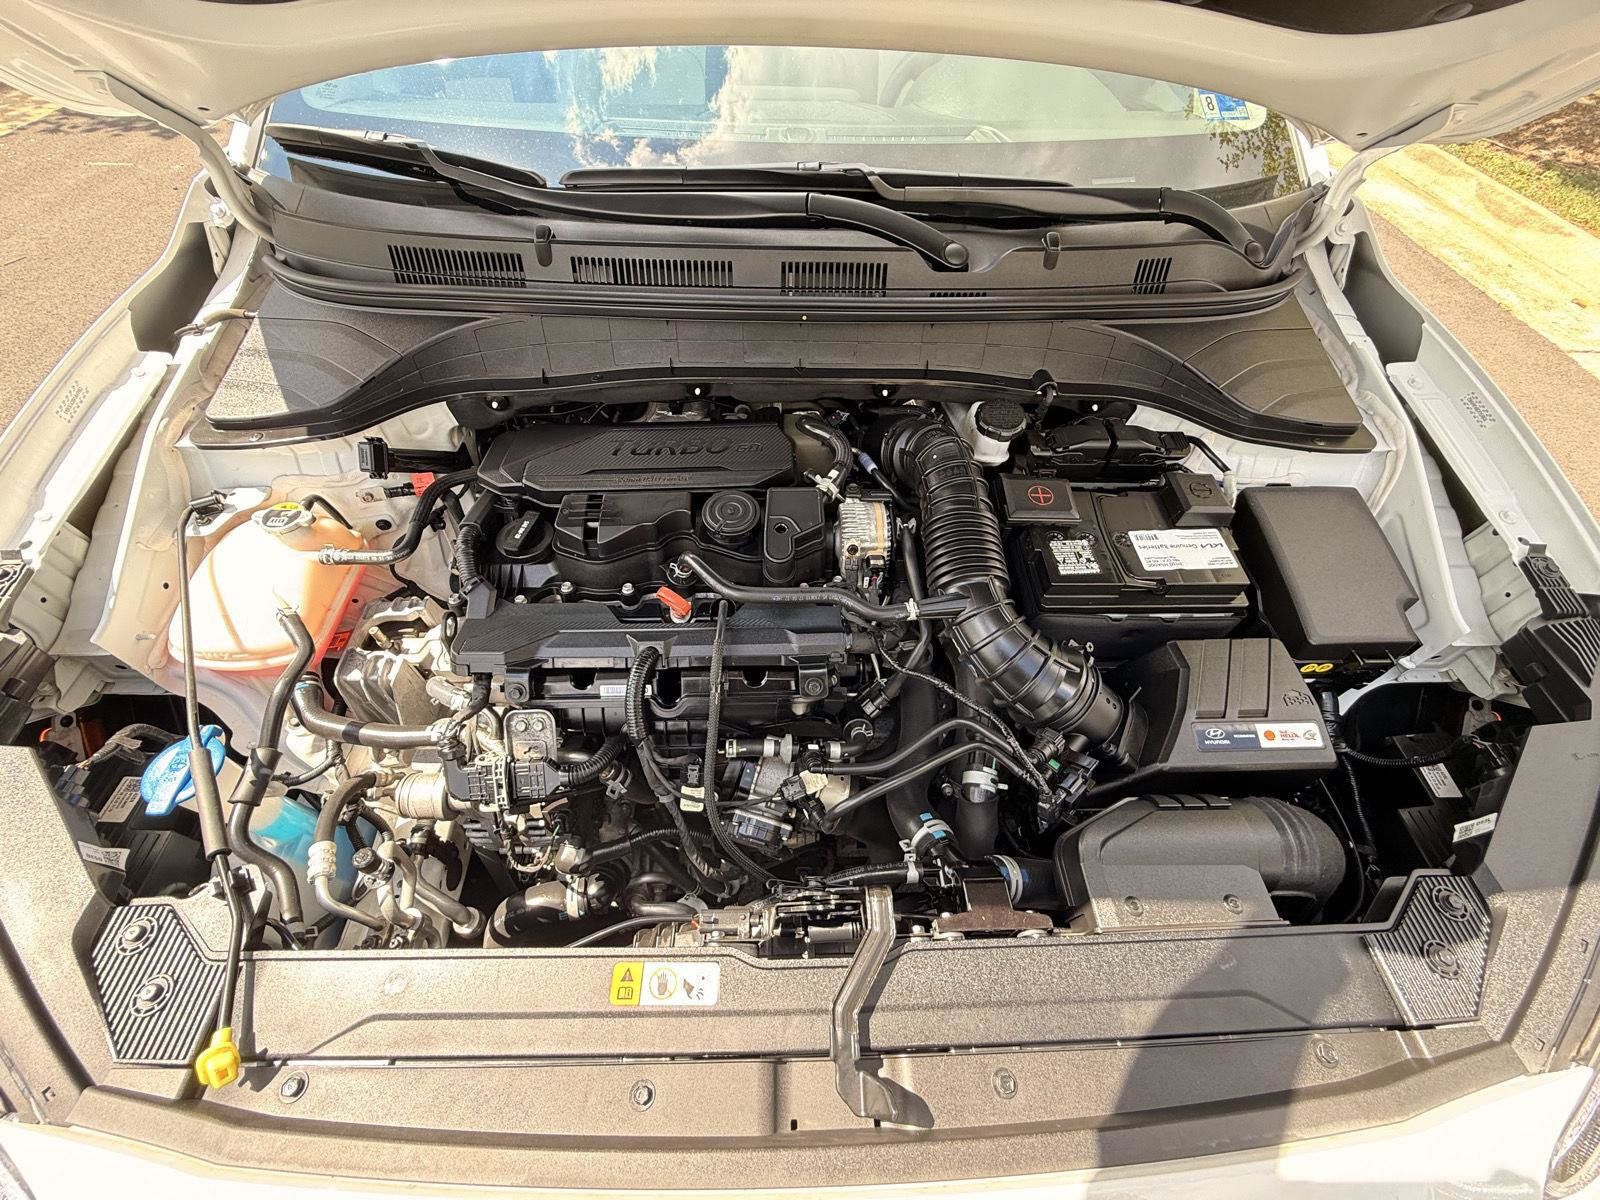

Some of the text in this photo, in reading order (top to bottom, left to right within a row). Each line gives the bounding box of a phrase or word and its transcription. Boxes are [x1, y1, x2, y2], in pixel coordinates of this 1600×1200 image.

[1205, 95, 1215, 111] 8
[610, 438, 732, 456] TURBO
[1138, 542, 1169, 550] Batteries
